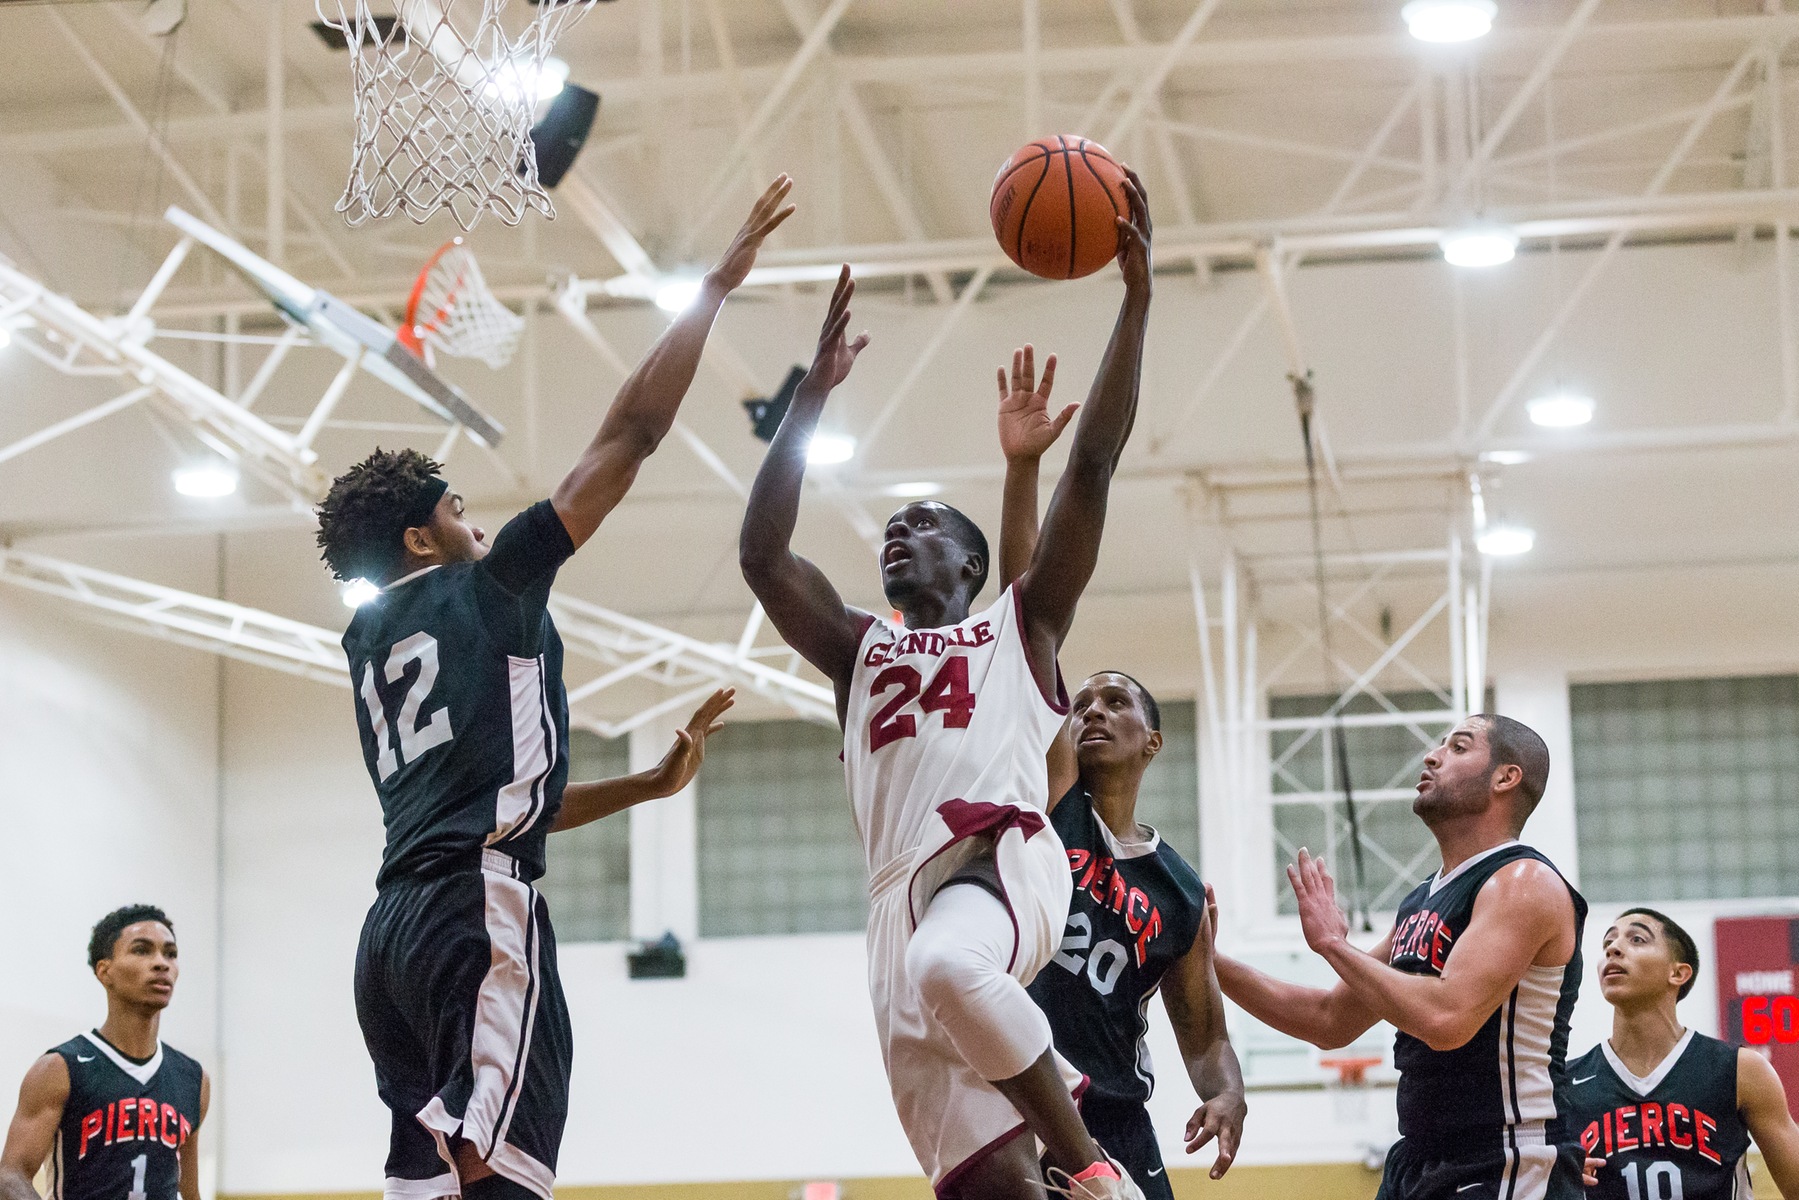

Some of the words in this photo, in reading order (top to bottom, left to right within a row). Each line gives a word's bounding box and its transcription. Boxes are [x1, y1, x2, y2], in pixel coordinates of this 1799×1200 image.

[864, 620, 995, 668] GLENDLE
[360, 630, 454, 784] 12
[870, 655, 976, 754] 24
[1052, 911, 1129, 996] 20
[1389, 909, 1452, 972] IERCE
[1742, 996, 1799, 1045] 60
[1580, 1102, 1722, 1166] PIERCE
[128, 1153, 149, 1200] 1
[1621, 1160, 1684, 1200] 10
